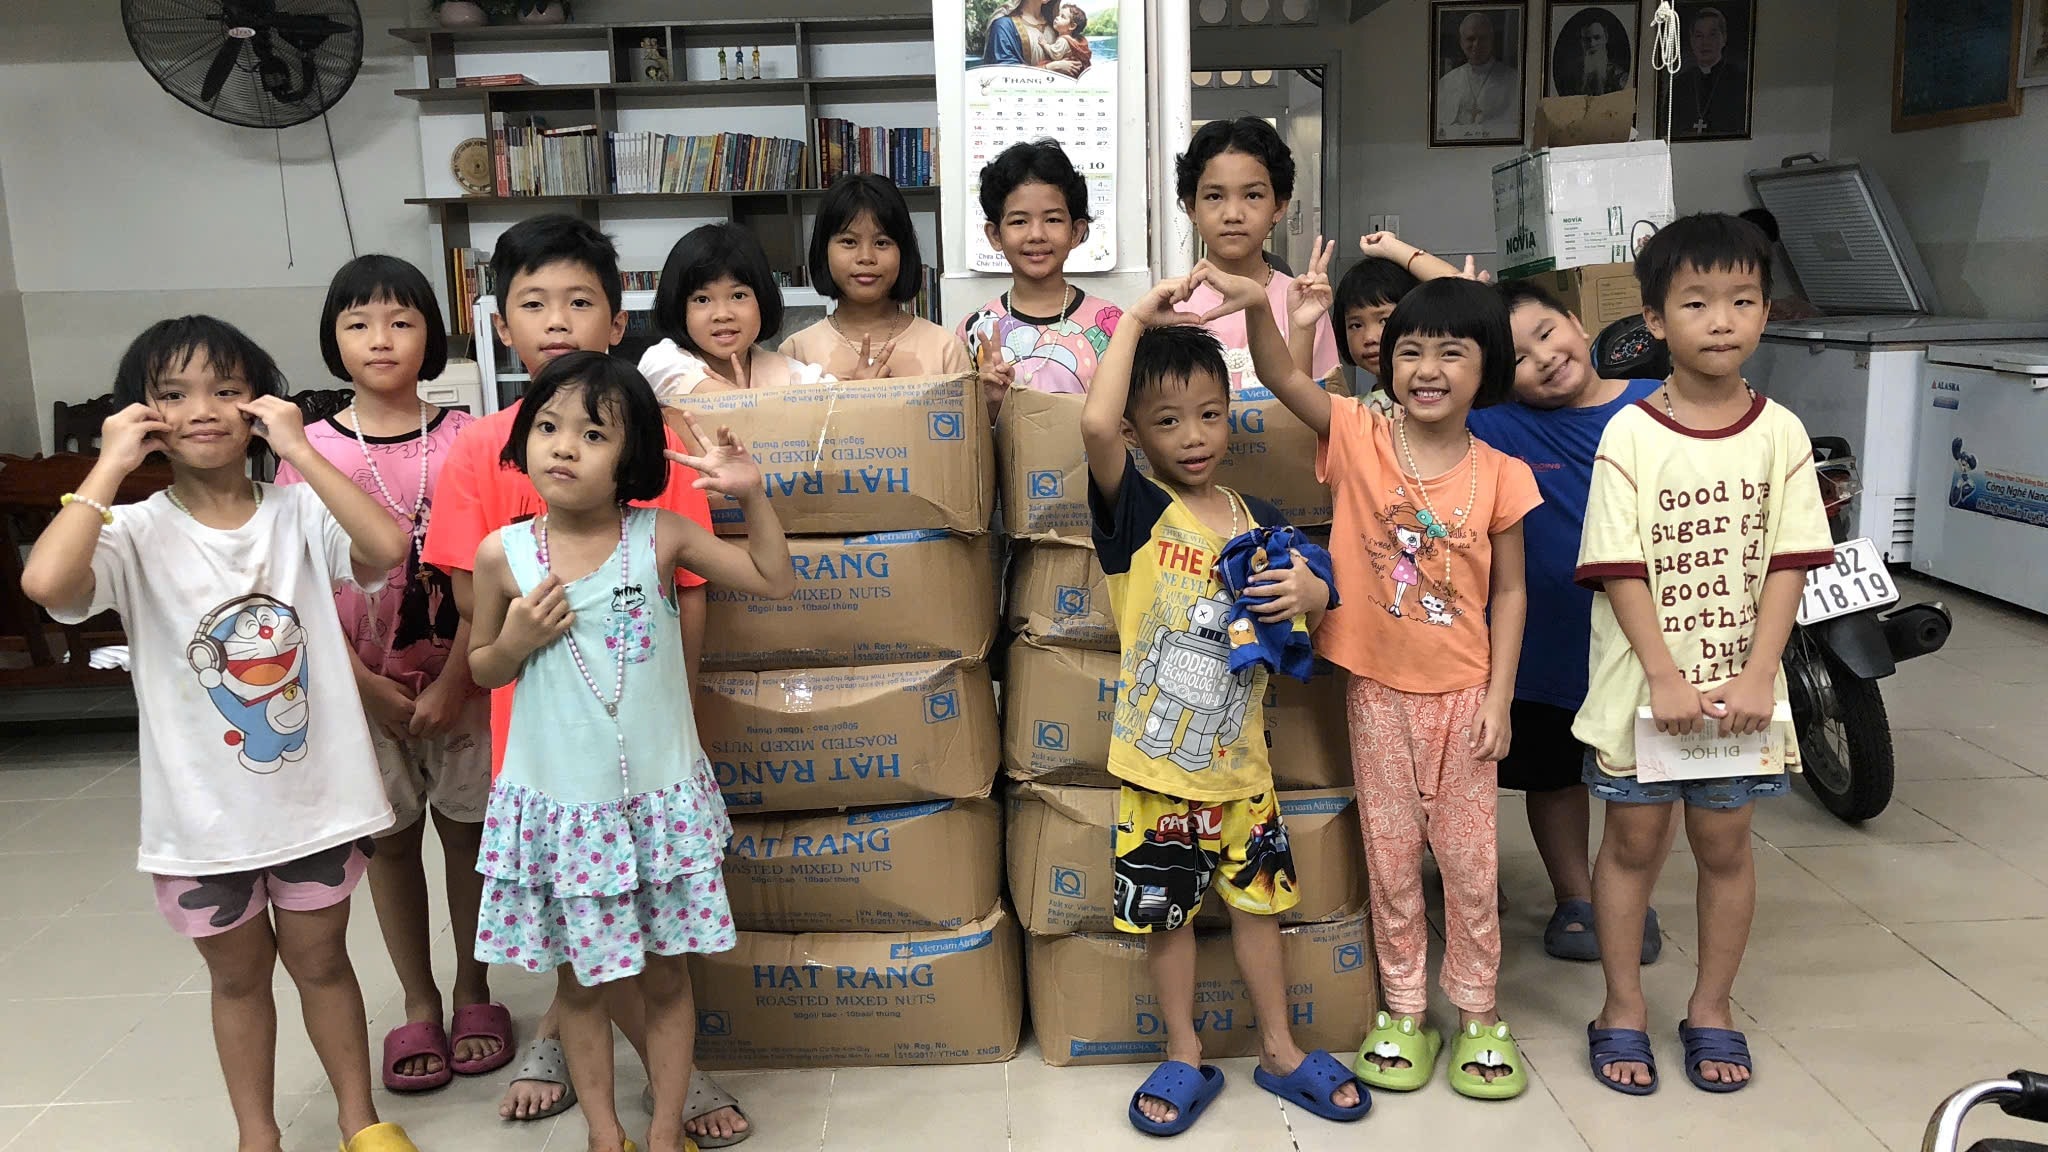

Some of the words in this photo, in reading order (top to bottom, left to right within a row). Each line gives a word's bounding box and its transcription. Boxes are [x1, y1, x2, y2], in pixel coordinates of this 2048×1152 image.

[1046, 76, 1055, 84] 9
[1089, 162, 1105, 170] 10
[1246, 388, 1273, 399] Vietn
[1937, 381, 1960, 392] ALASKA
[932, 413, 961, 438] IQ
[1227, 408, 1265, 434] NG
[769, 450, 825, 465] MIXED
[831, 447, 908, 461] ROASTED
[765, 469, 825, 498] RAN
[838, 464, 910, 494] HẠT
[1032, 472, 1058, 497] IQ
[1658, 481, 1730, 512] Good
[711, 511, 741, 521] Viet
[1313, 507, 1334, 517] XNC
[873, 530, 914, 541] Vietnam
[1650, 514, 1731, 545] Sugar
[791, 551, 890, 580] RANG
[1158, 540, 1204, 576] THE
[1654, 544, 1729, 576] sugar
[790, 588, 842, 600] MIXED
[849, 585, 892, 599] NUTS
[1057, 587, 1085, 614] IQ
[1660, 574, 1730, 607] good
[1700, 634, 1748, 660] but
[1165, 647, 1225, 680] MODERN
[1159, 661, 1218, 692] TECHNOLOGY
[928, 692, 956, 720] IQ
[712, 740, 753, 753] NUTS
[761, 737, 815, 753] MIXED
[821, 734, 898, 751] ROASTED
[1037, 721, 1063, 749] IQ
[1680, 743, 1718, 760] HỌC
[1723, 745, 1740, 757] ĐI
[714, 758, 816, 788] RANG
[828, 752, 901, 782] HẠT
[876, 807, 918, 819] Vietnam
[1281, 803, 1312, 812] etnam
[792, 827, 891, 857] RANG
[790, 862, 843, 875] MIXED
[850, 860, 893, 873] NUTS
[1054, 869, 1080, 895] IQ
[938, 917, 962, 928] XNCB
[918, 941, 957, 953] Vietnam
[1338, 943, 1364, 970] IQ
[753, 964, 825, 992] HẠT
[835, 963, 934, 990] RANG
[755, 994, 830, 1007] ROASTED
[835, 994, 888, 1007] MIXED
[895, 992, 937, 1005] NUTS
[1194, 989, 1235, 1003] MIXE
[1135, 1007, 1233, 1035] RAG
